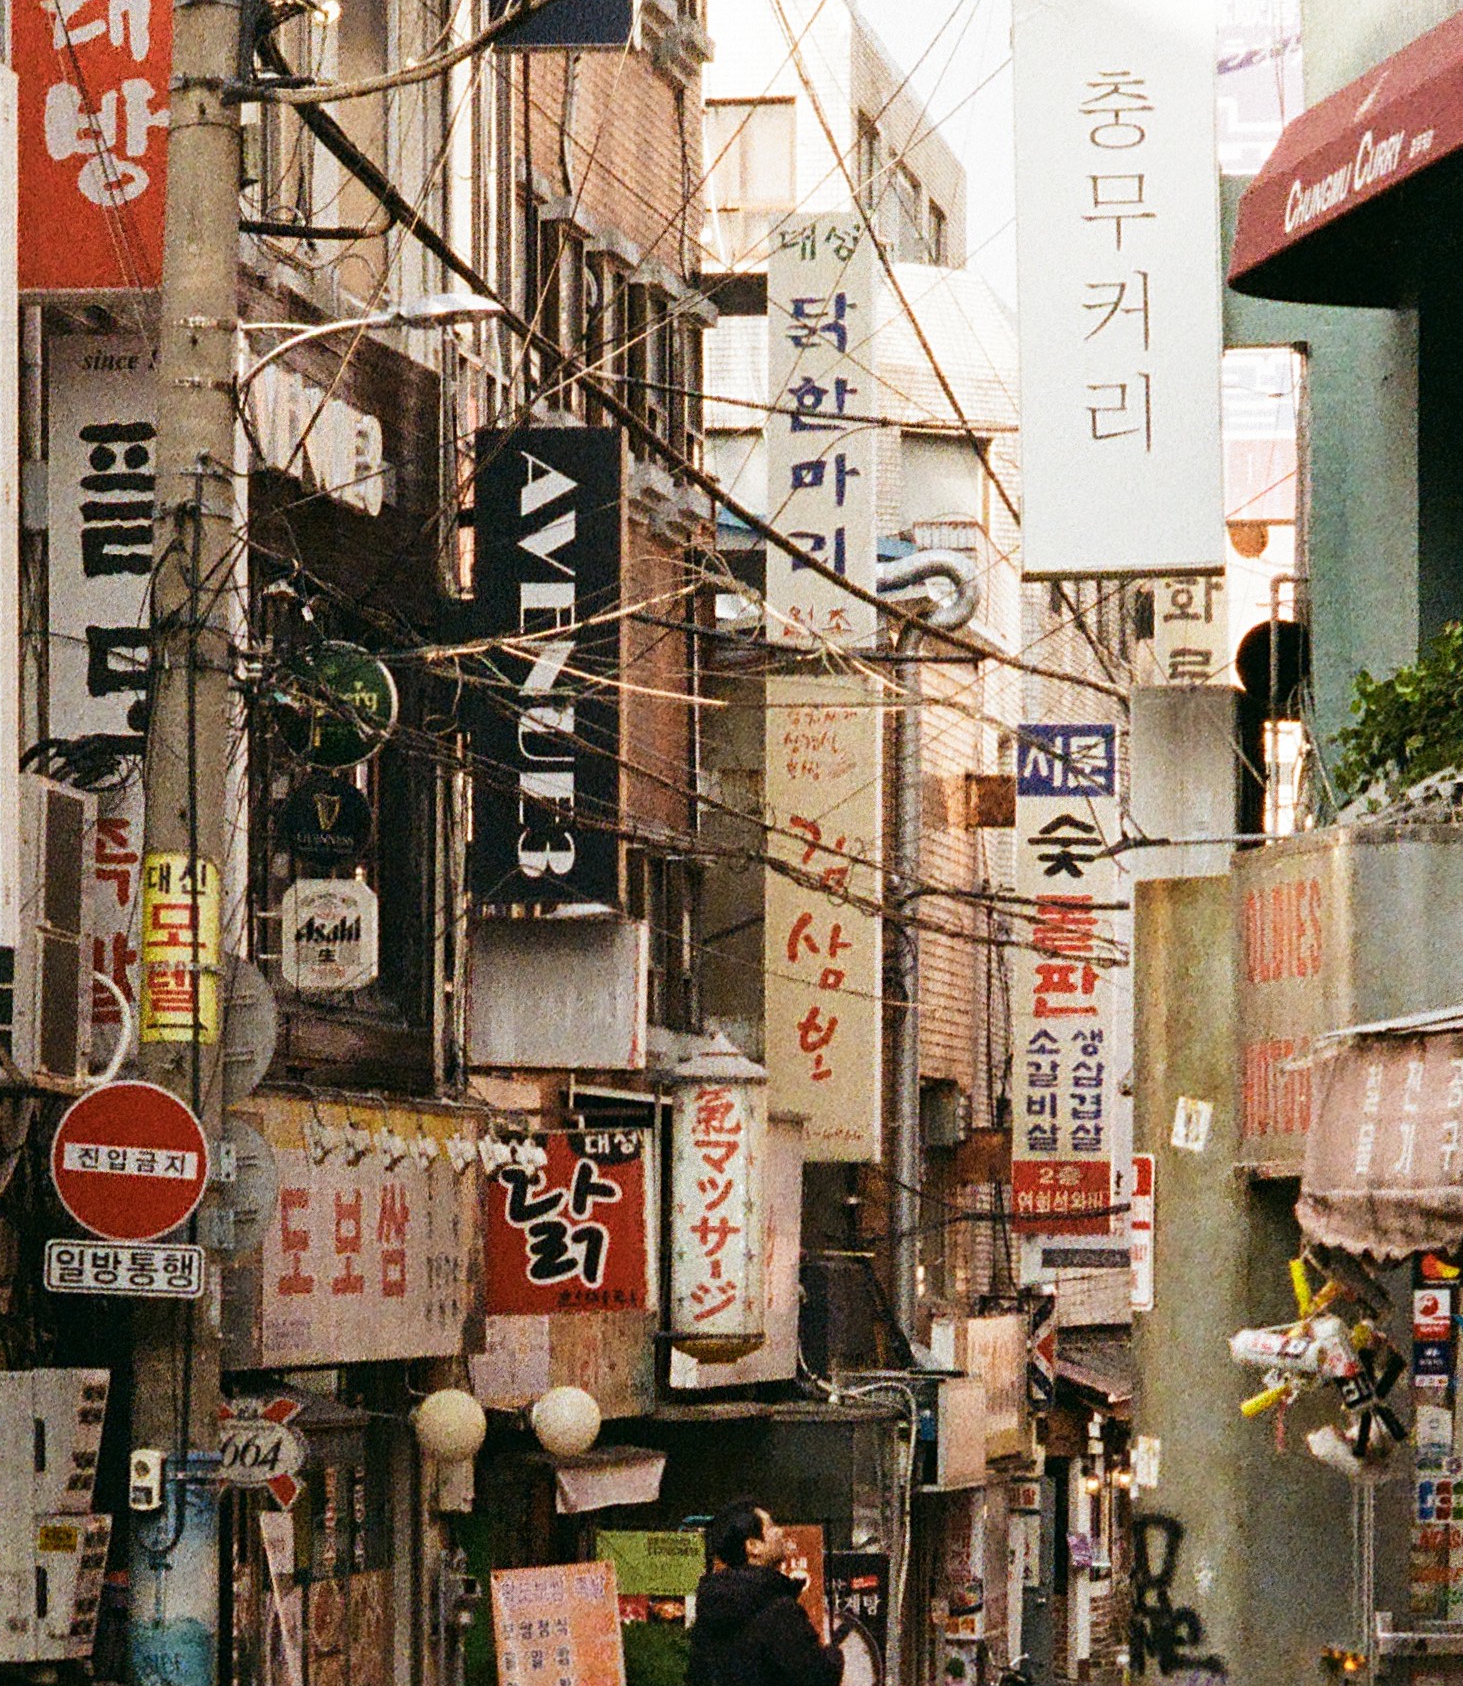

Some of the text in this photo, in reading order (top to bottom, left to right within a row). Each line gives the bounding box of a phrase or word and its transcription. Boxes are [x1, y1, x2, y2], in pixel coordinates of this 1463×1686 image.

[1078, 70, 1157, 453] 충무커리
[517, 451, 578, 824] AVENUE
[296, 915, 361, 944] Asahi
[78, 1147, 186, 1176] 진입금지
[55, 1249, 194, 1288] 일방통행
